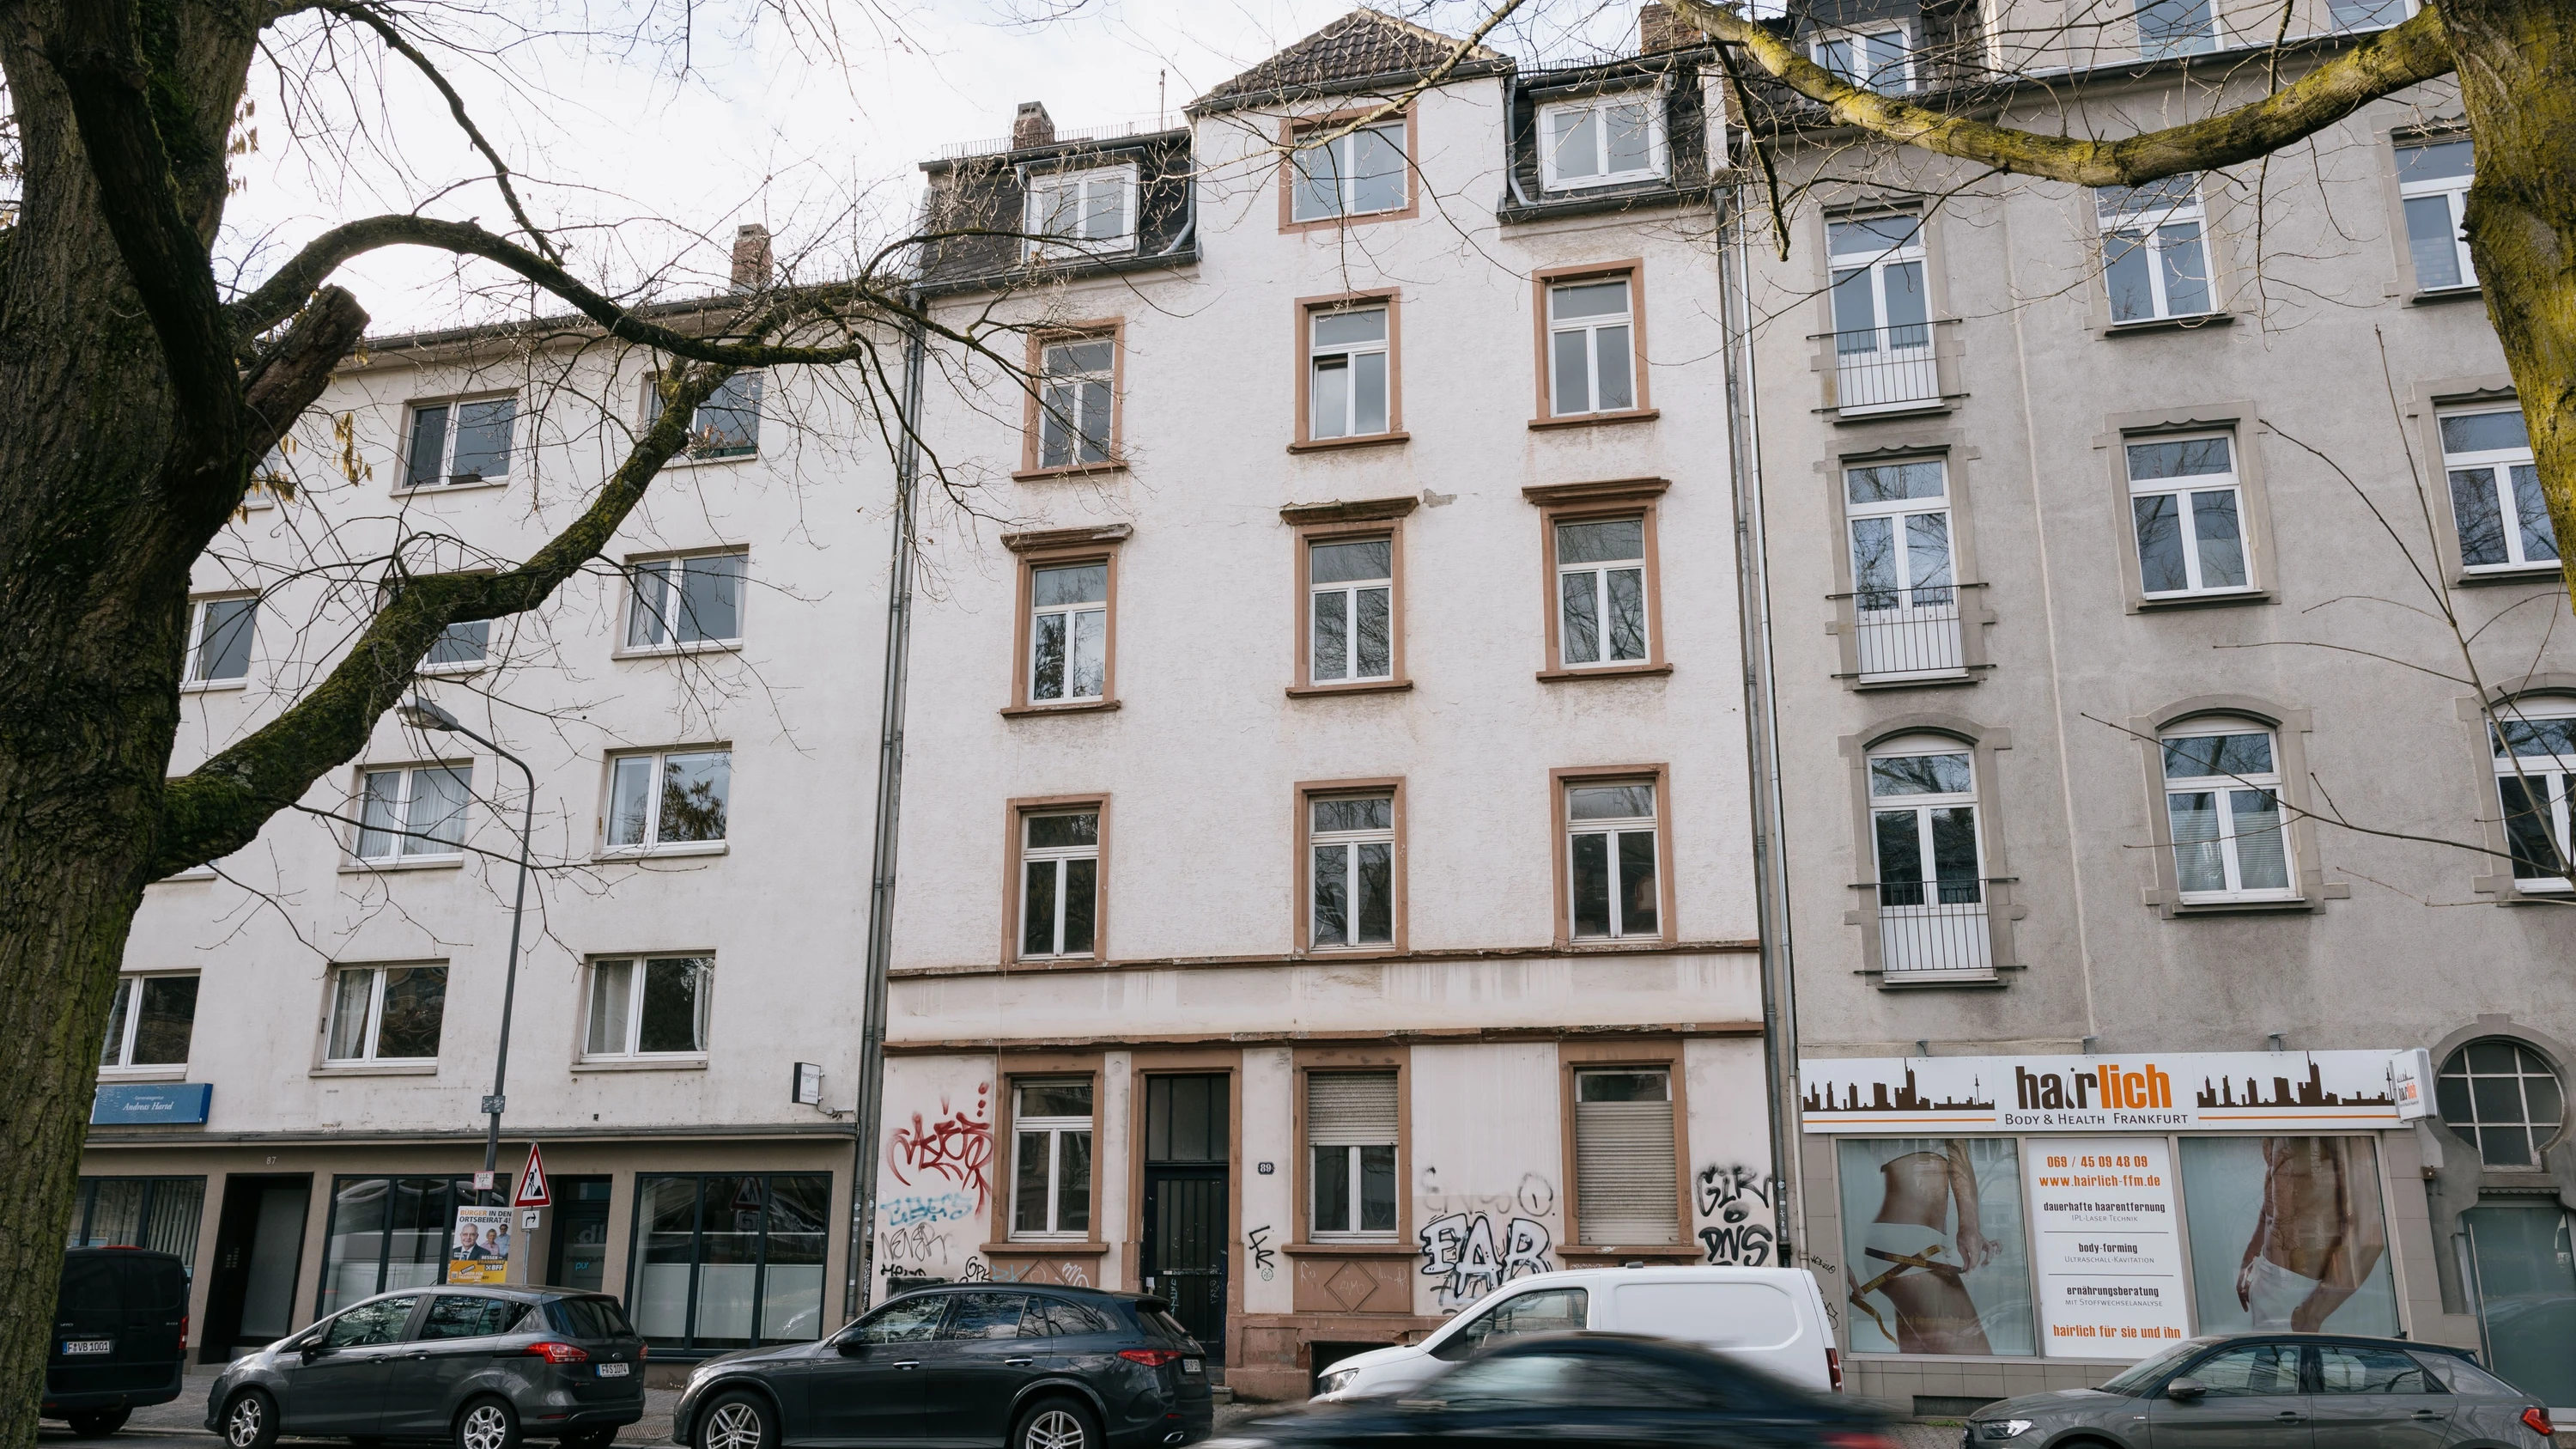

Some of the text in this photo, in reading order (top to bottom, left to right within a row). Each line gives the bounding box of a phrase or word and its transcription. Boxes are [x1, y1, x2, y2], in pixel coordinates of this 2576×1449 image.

[2015, 1064, 2172, 1109] hairlich
[123, 1101, 174, 1111] Andreas Hartel
[2044, 1114, 2054, 1125] &
[2113, 1112, 2188, 1124] FRANKFURT
[266, 1156, 276, 1165] 87
[2046, 1155, 2148, 1167] 069 / 45 09 48 09
[1260, 1164, 1273, 1173] 89
[2038, 1174, 2160, 1187] www.hairlich-ffm.de
[2044, 1202, 2166, 1213] dauerhafte haarentfernung
[2079, 1243, 2138, 1254] body-forming
[574, 1262, 589, 1271] pur
[2067, 1286, 2160, 1297] ernährungsberatung
[2053, 1324, 2181, 1339] hairlich für sie und ihn
